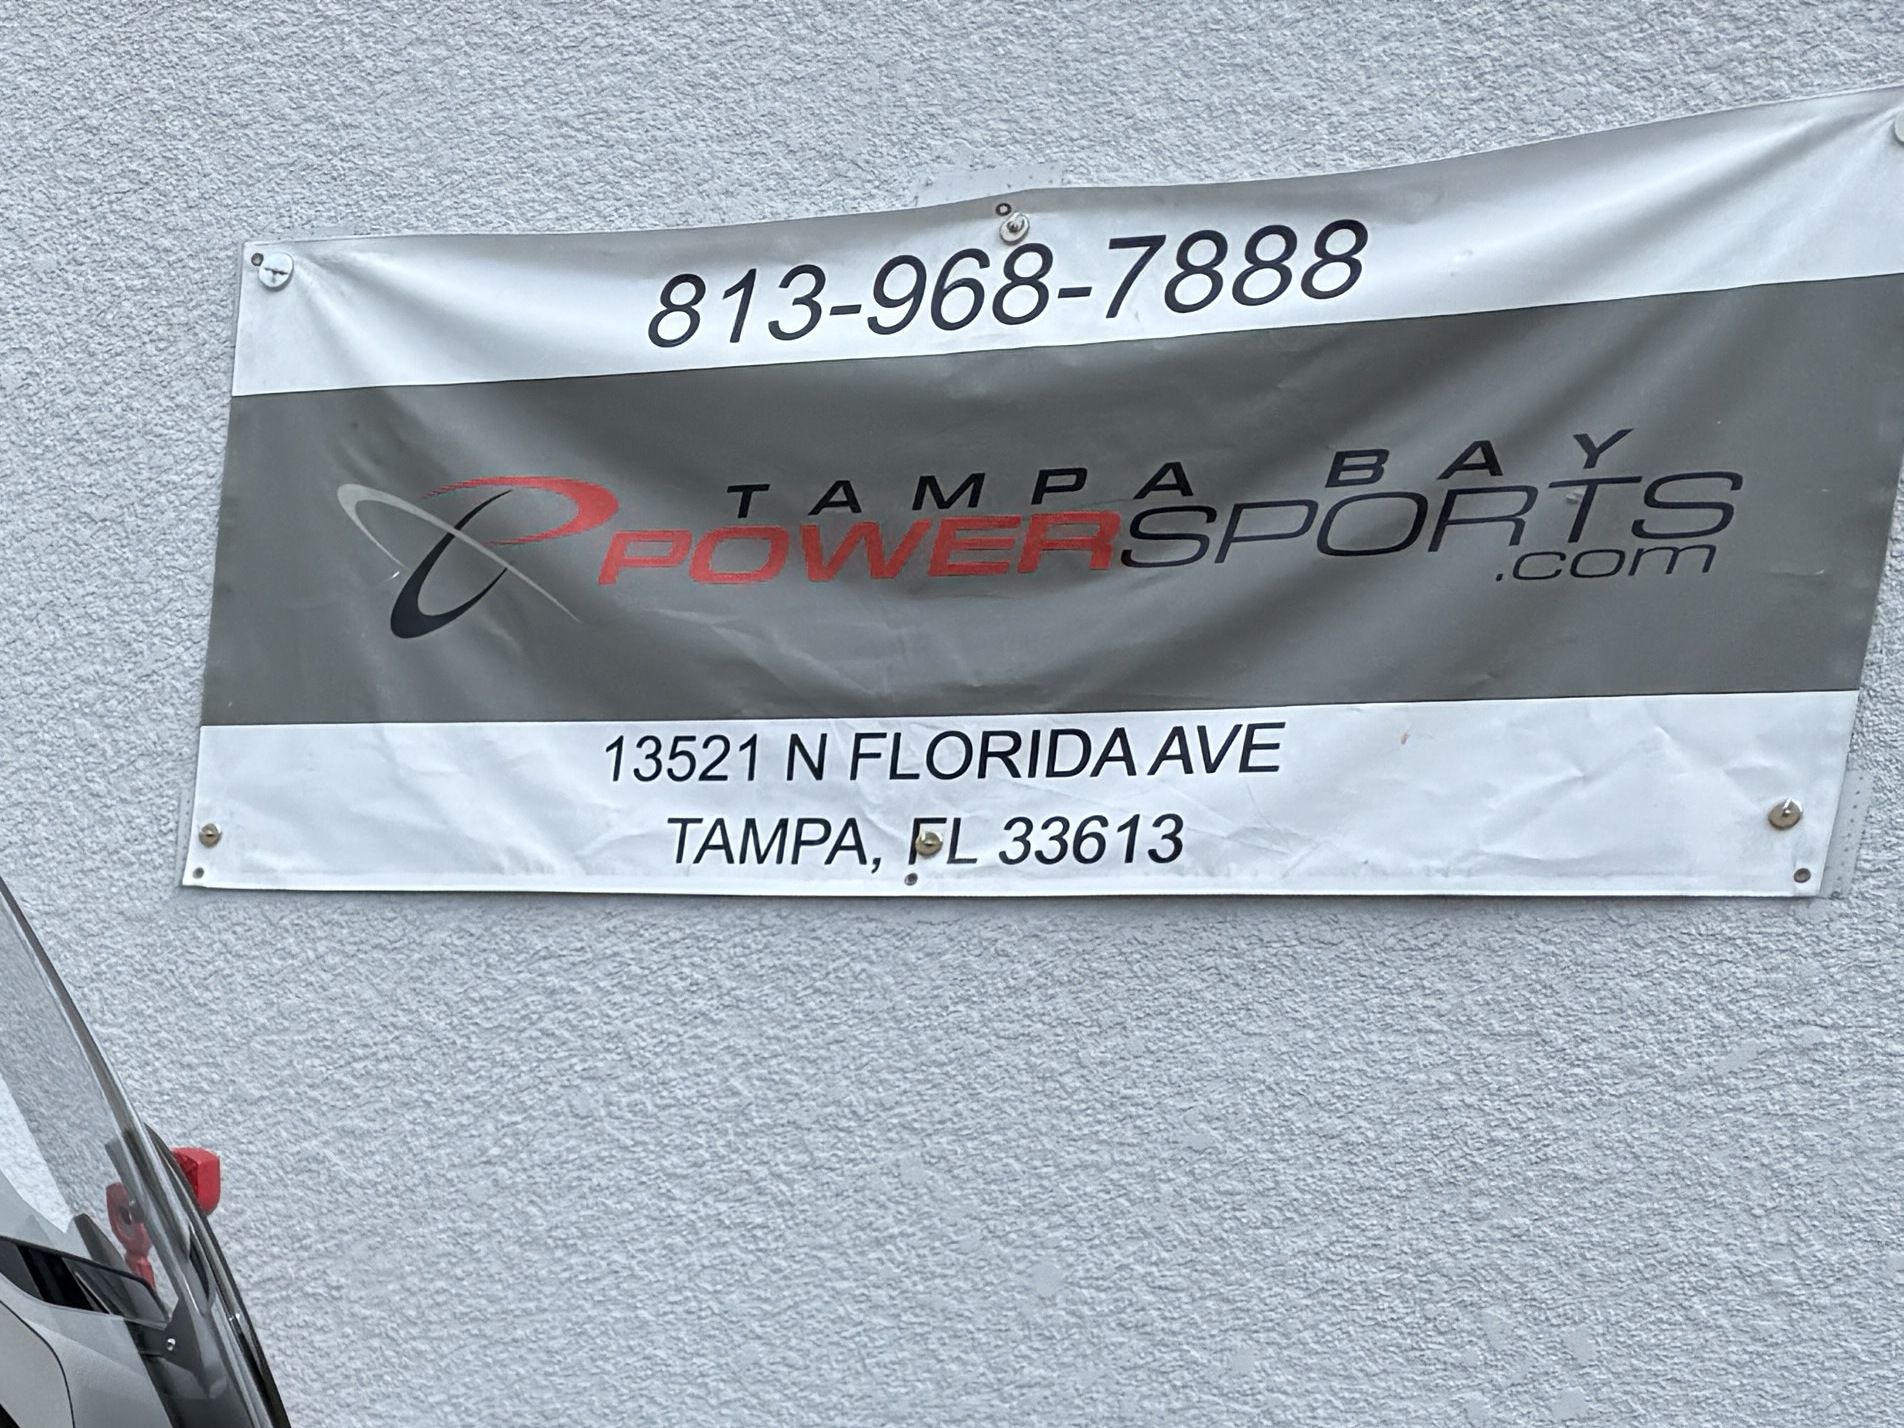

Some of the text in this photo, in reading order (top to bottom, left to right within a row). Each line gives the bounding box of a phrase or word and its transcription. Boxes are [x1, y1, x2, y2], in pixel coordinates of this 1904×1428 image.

[646, 218, 1370, 348] 813-968-7888
[724, 427, 1637, 518] TAMPA BAY
[596, 468, 1745, 586] POWERSPORTS
[1494, 543, 1718, 582] .com
[603, 722, 1287, 782] 13521 N FLORIDA AVE
[665, 812, 1185, 874] TAMPA, FL 33613
